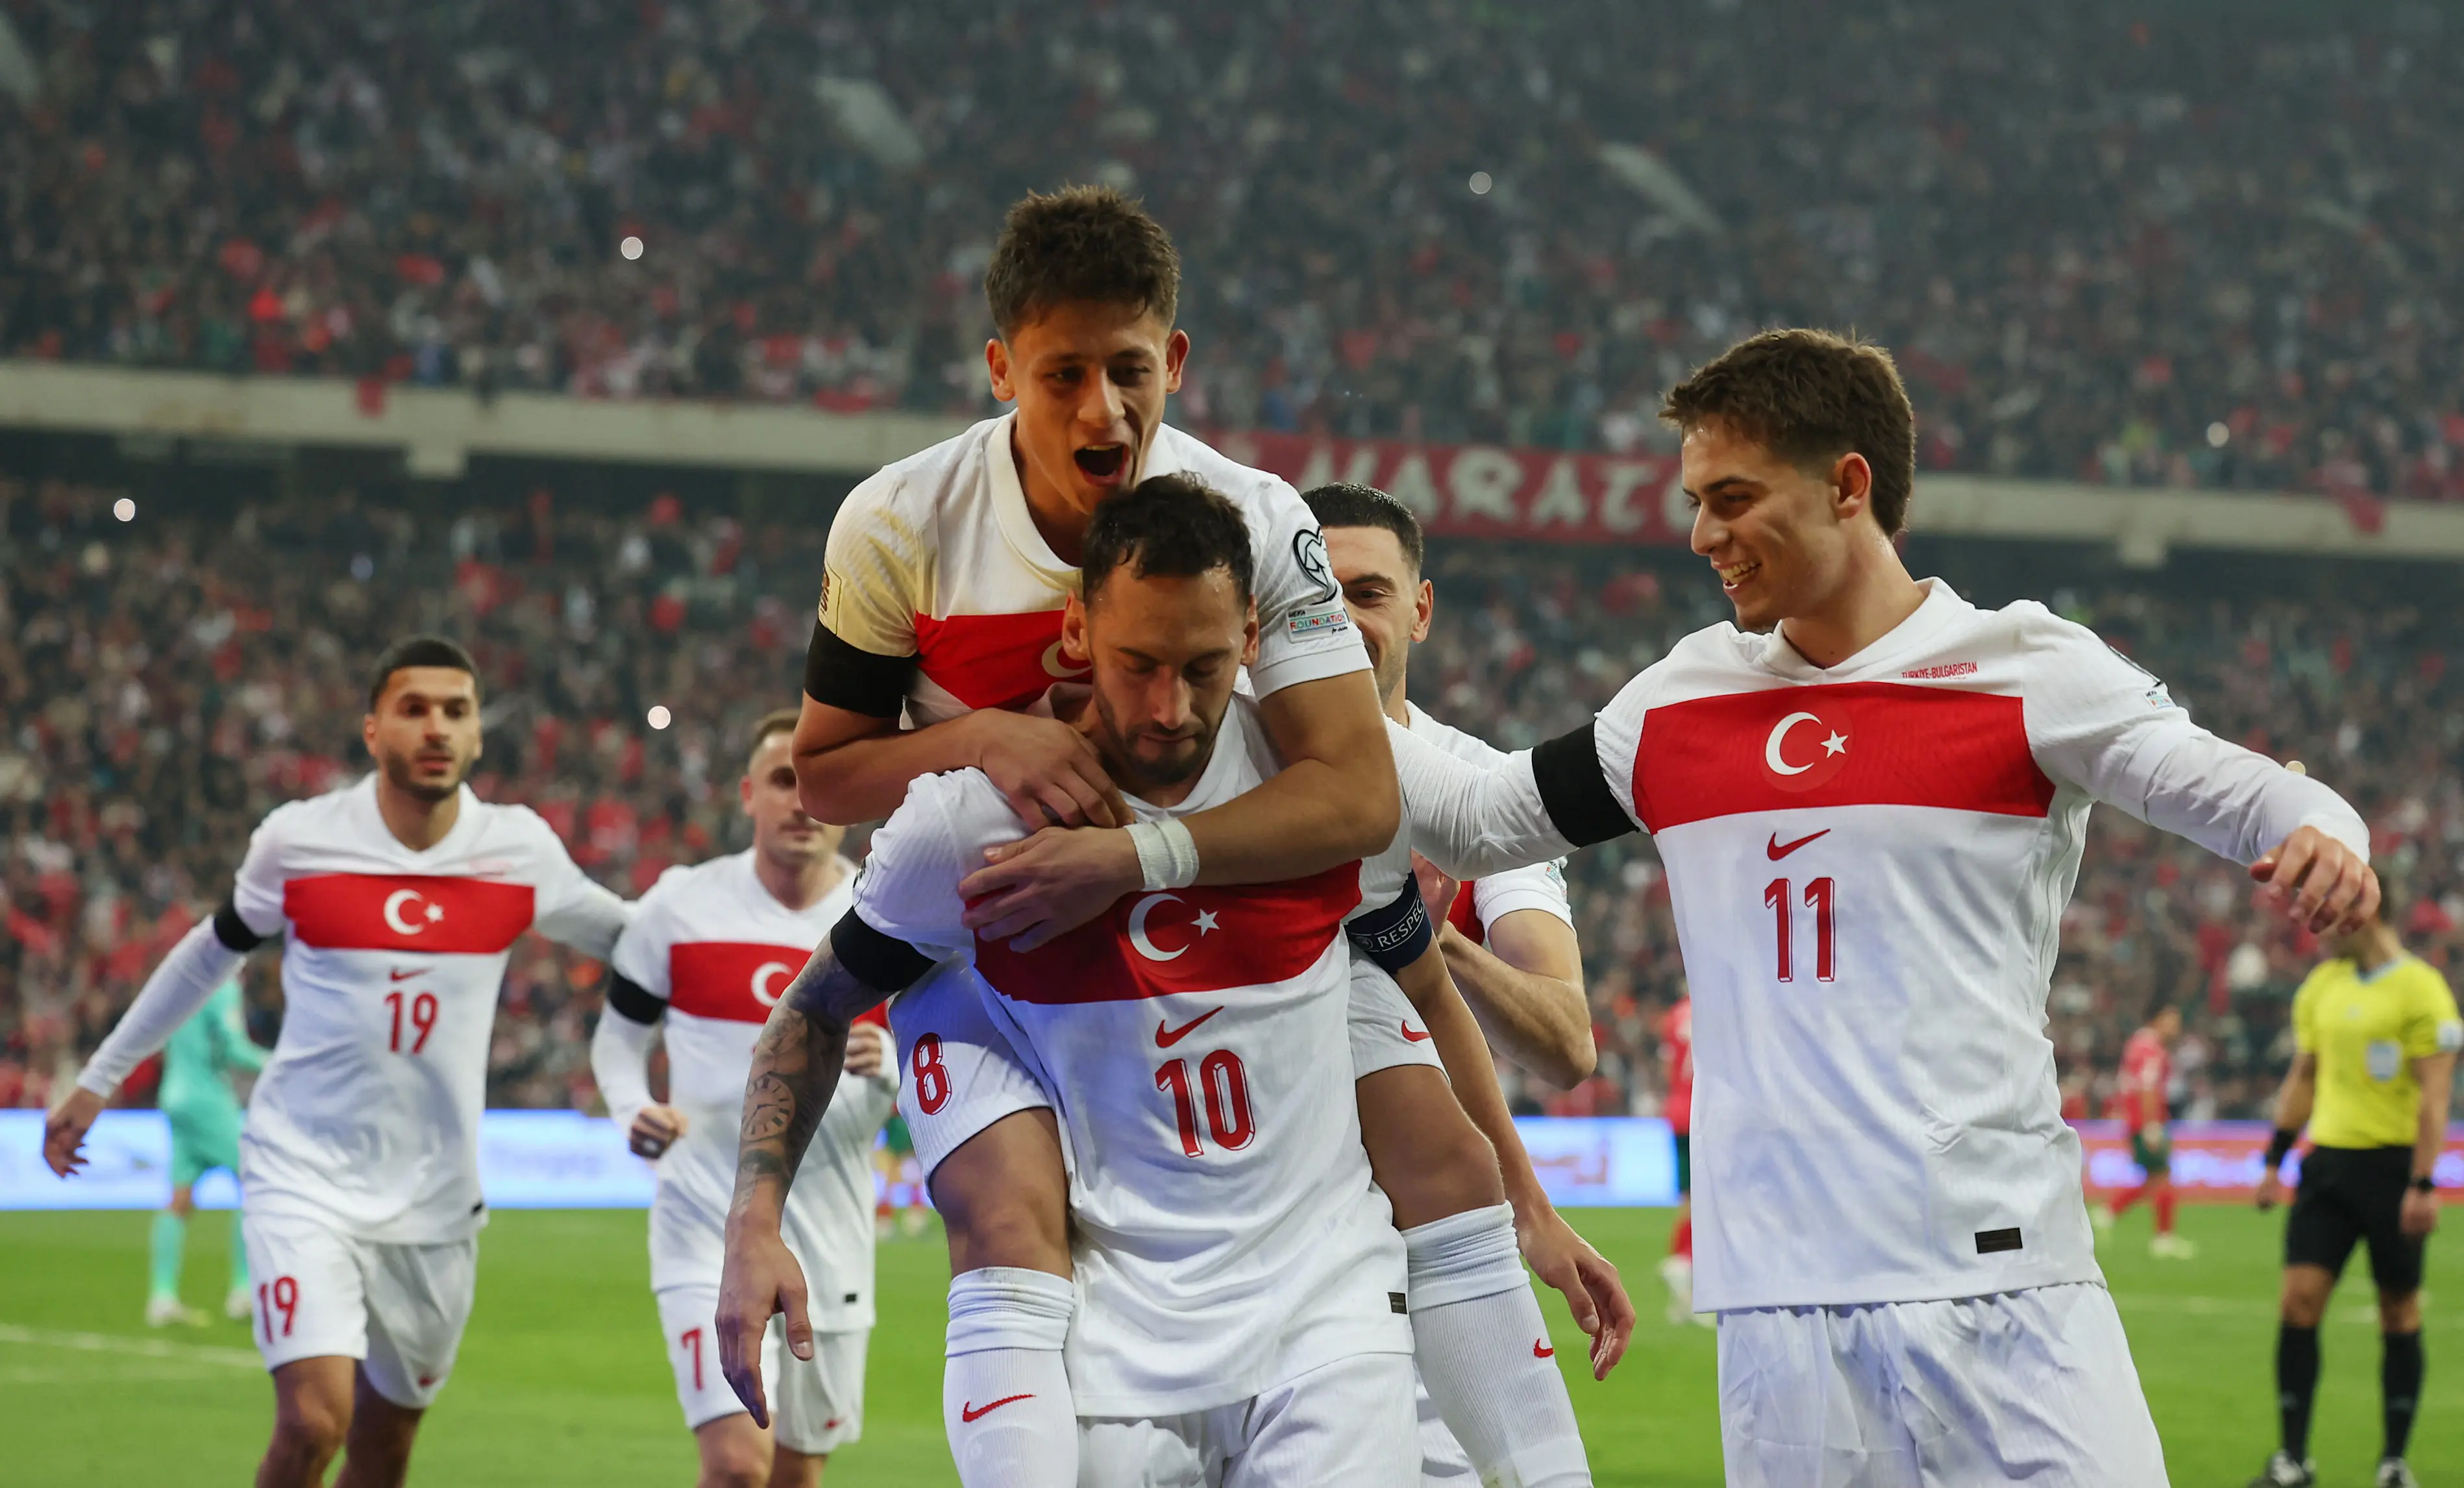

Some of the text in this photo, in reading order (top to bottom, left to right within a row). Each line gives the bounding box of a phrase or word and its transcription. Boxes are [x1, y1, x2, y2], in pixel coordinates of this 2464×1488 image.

[1764, 877, 1836, 983] 11
[384, 991, 439, 1056] 19
[912, 1032, 952, 1116] 8
[1155, 1049, 1256, 1158] 10
[260, 1276, 299, 1345] 19
[681, 1326, 704, 1391] 7
